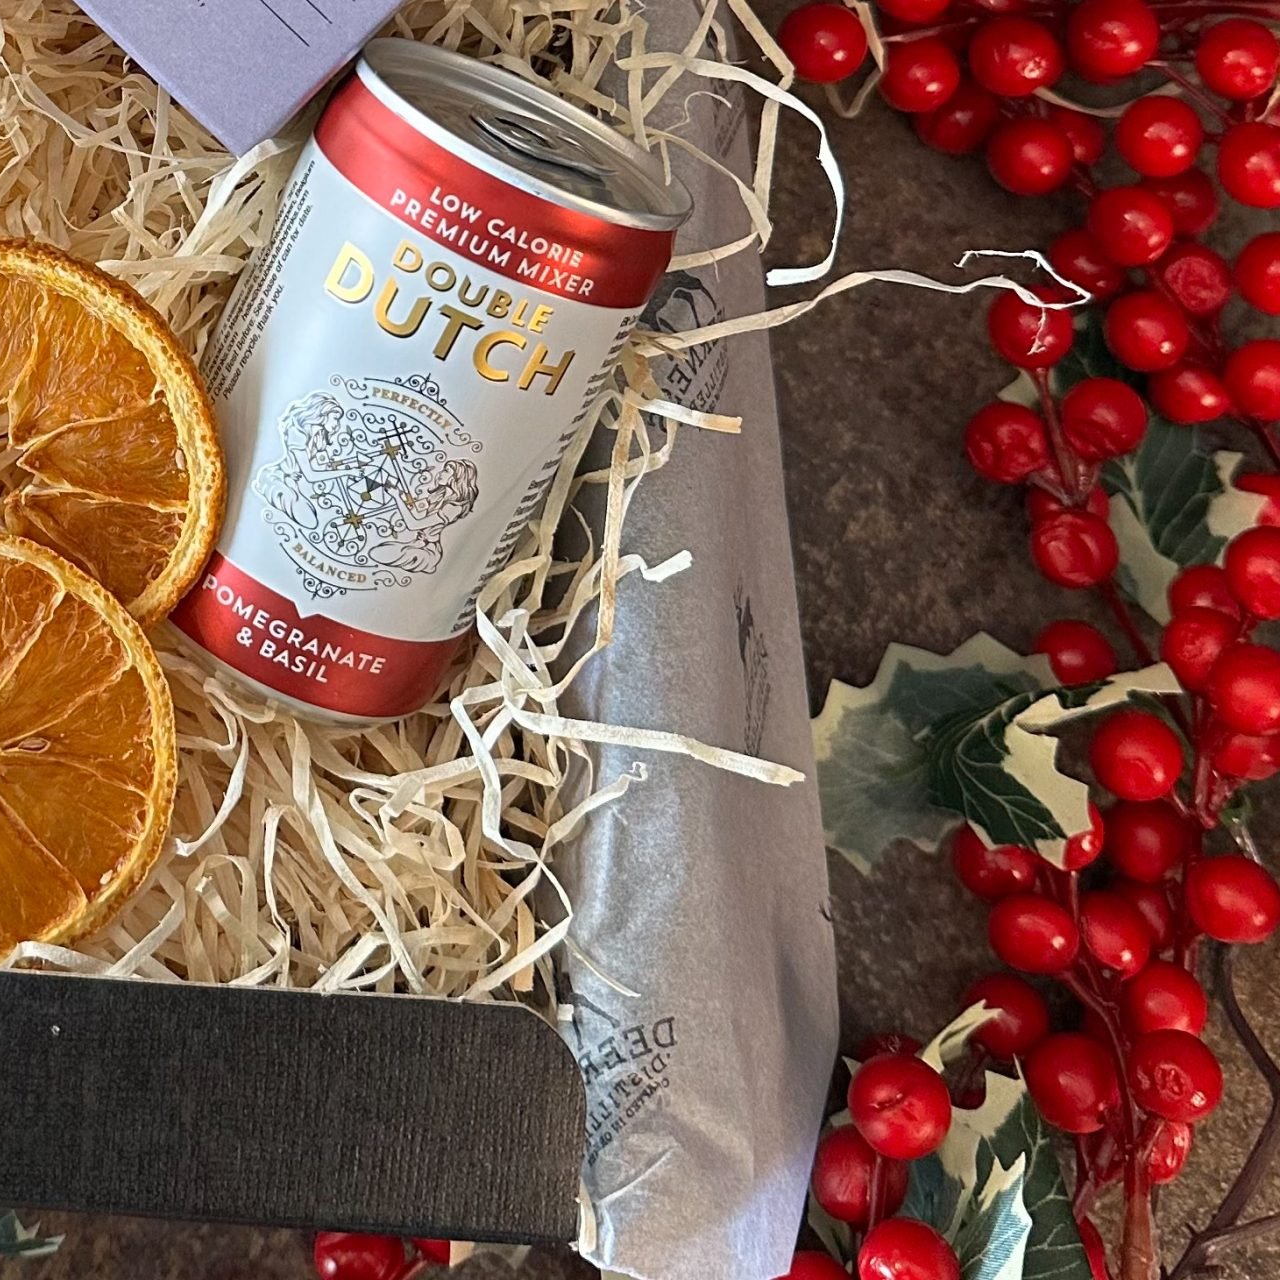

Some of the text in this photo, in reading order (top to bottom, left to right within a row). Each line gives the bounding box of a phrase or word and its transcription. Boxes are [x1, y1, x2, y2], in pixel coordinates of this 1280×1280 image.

[251, 296, 267, 317] See
[261, 272, 279, 297] base
[272, 259, 285, 273] of
[280, 242, 294, 262] can
[289, 226, 302, 242] for
[296, 201, 314, 228] date.
[389, 188, 594, 296] PREMIUM MIXER
[429, 186, 584, 268] LOW CALORIE
[237, 330, 263, 369] recycle,
[254, 303, 275, 332] thank
[269, 282, 287, 307] you.
[324, 241, 577, 396] DUTCH
[392, 239, 554, 334] DOUBLE
[371, 386, 453, 431] PERFECTLY
[292, 543, 368, 584] BALANCED
[202, 574, 387, 674] POMEGRANATE
[236, 626, 328, 683] & BASIL
